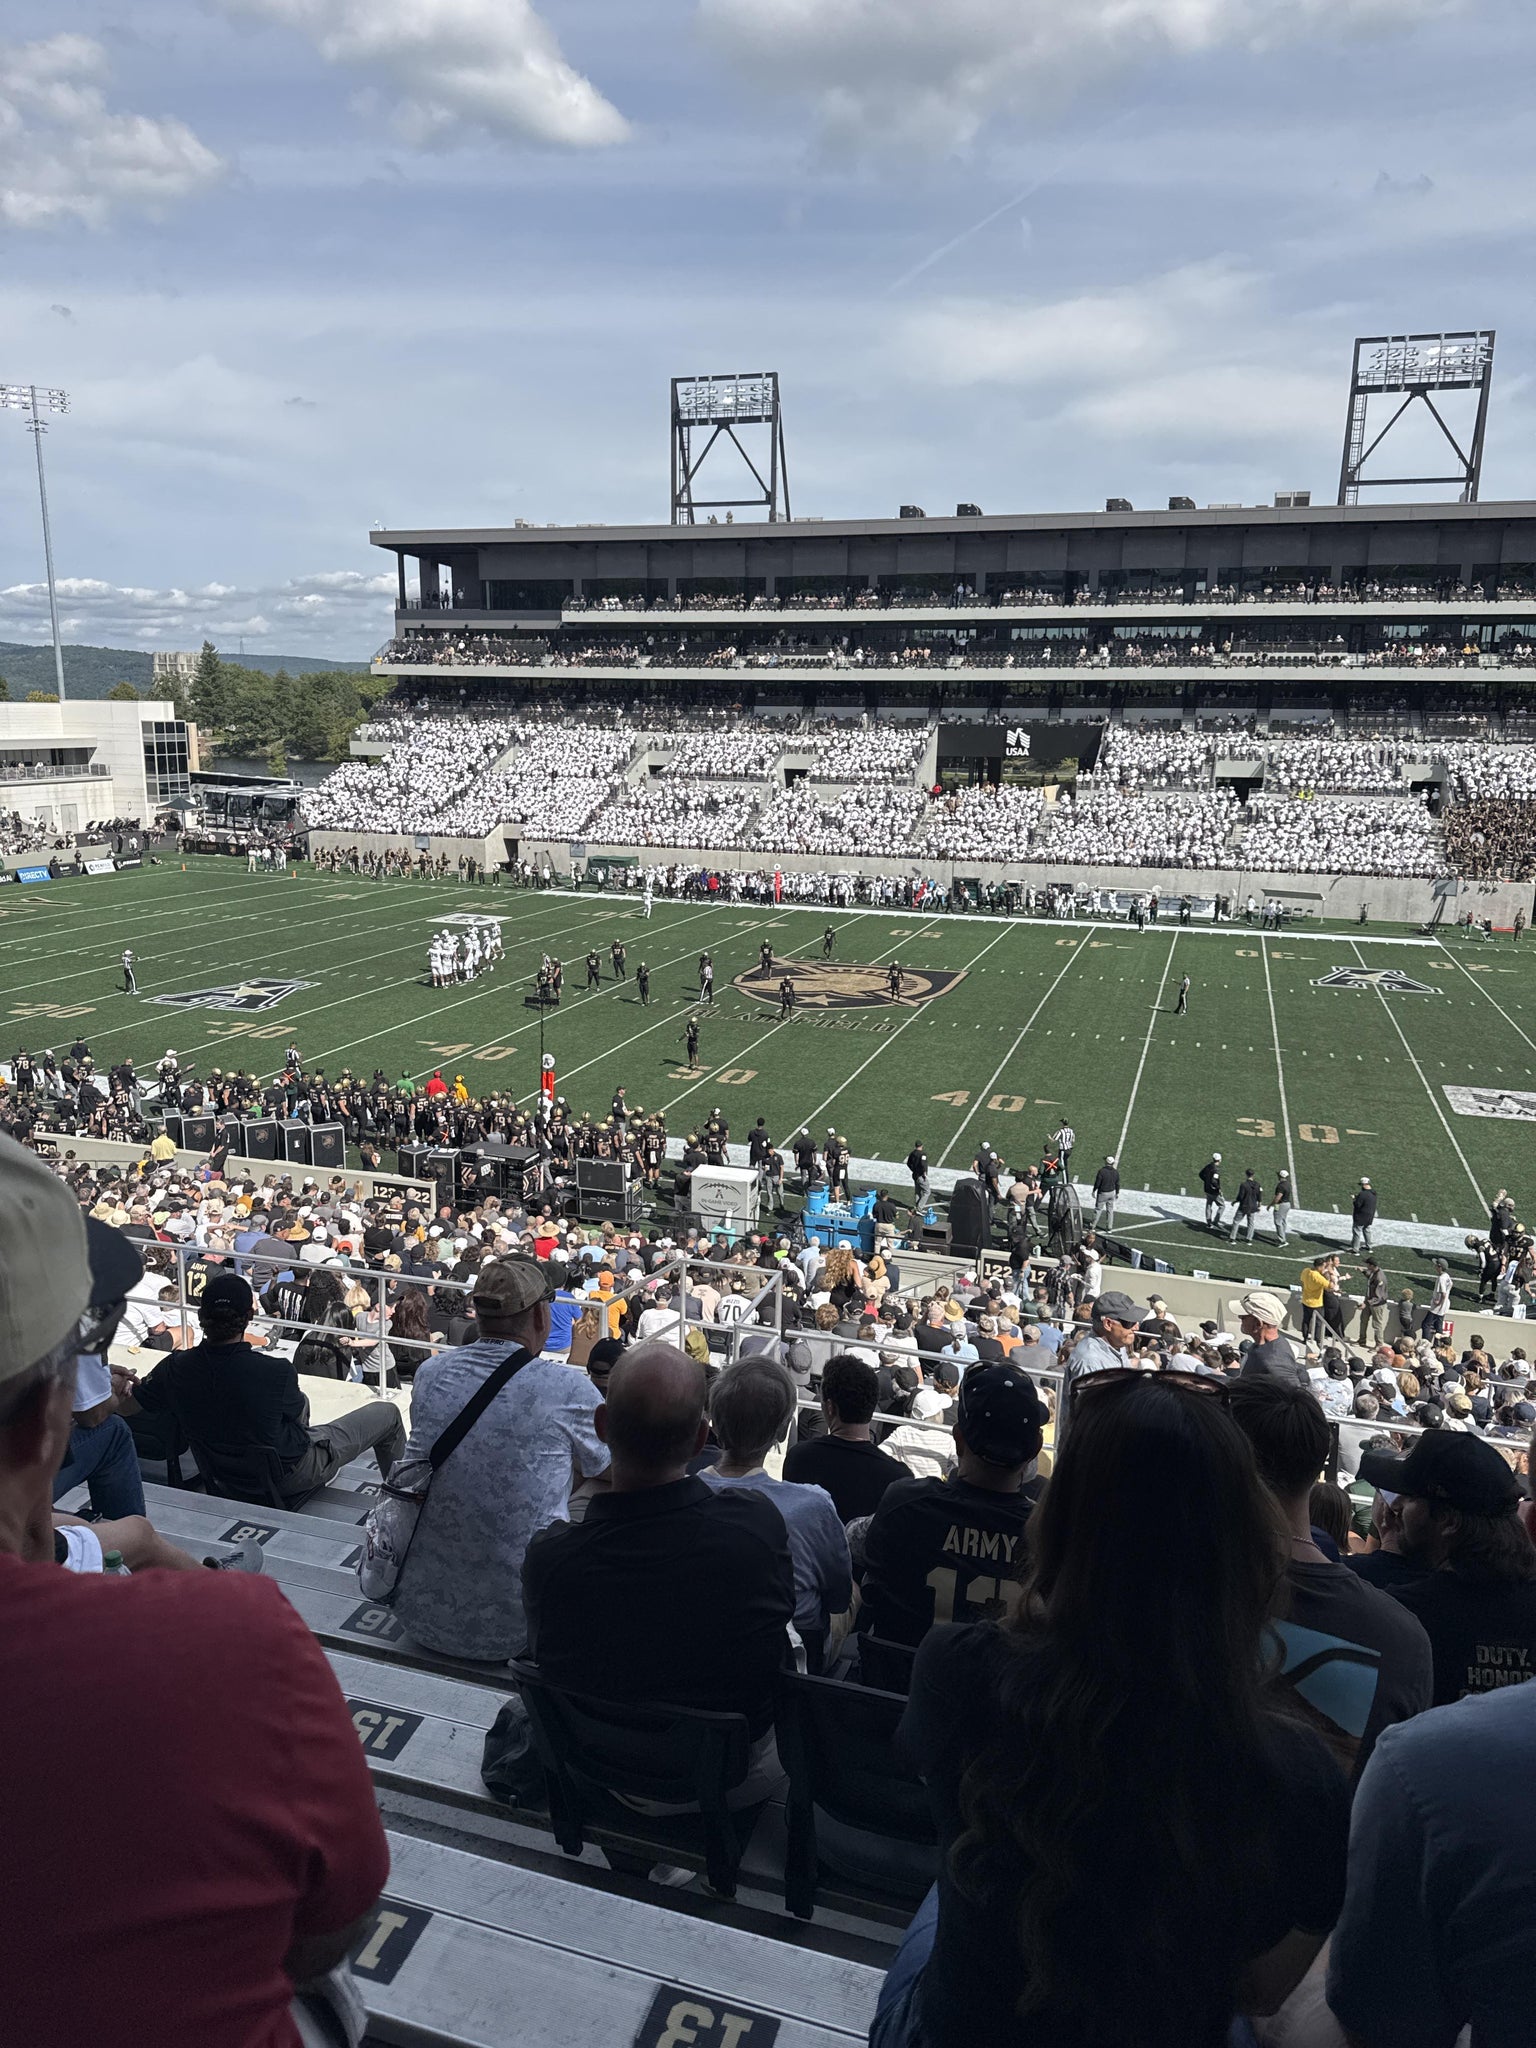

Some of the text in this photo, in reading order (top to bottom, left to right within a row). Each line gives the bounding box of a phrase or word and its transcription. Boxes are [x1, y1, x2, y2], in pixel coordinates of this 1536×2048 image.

[1006, 747, 1030, 756] USAA
[20, 870, 48, 881] DIRECTV
[429, 1043, 519, 1060] 40
[16, 1060, 29, 1070] 78
[667, 1065, 759, 1085] 50
[116, 1093, 129, 1104] 20
[930, 1090, 1027, 1113] 40
[1478, 1105, 1536, 1117] USA
[551, 1125, 564, 1136] 37
[1236, 1117, 1340, 1144] 30
[190, 1262, 208, 1272] ARMY
[985, 1263, 1012, 1278] 122
[186, 1271, 207, 1297] 12
[722, 1304, 741, 1322] 70
[231, 1526, 269, 1544] 18
[942, 1525, 1019, 1563] ARMY
[355, 1609, 398, 1636] 16
[1475, 1645, 1531, 1667] DUTY.
[352, 1709, 406, 1750] 15
[354, 1910, 409, 1970] 1
[655, 2000, 754, 2048] 13
